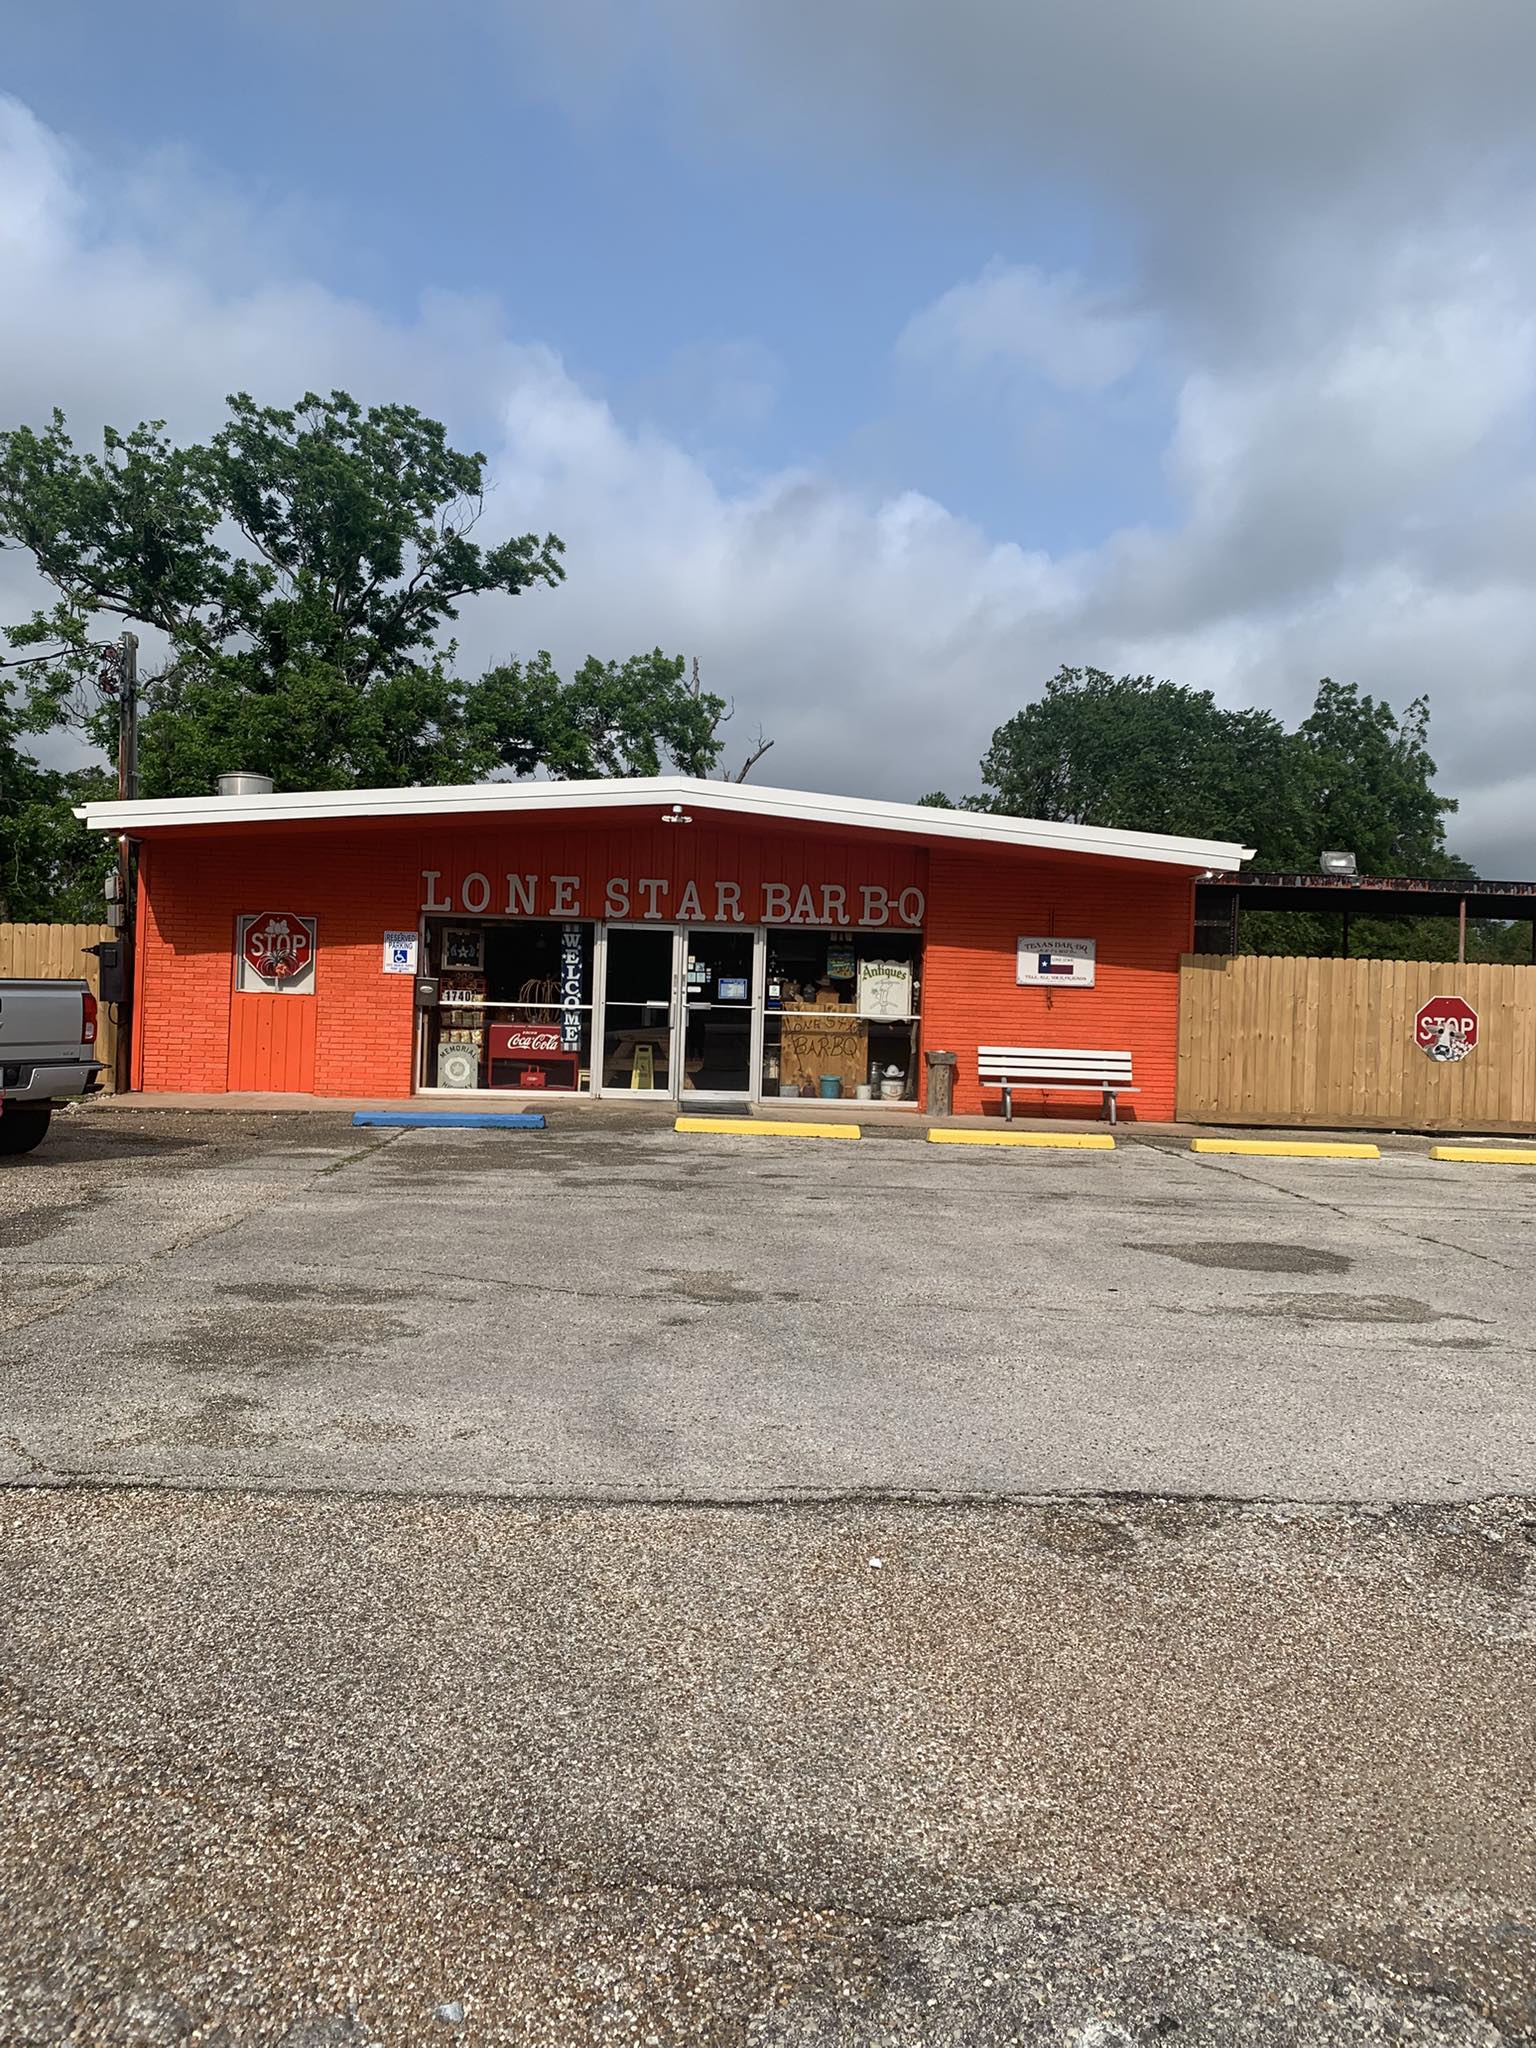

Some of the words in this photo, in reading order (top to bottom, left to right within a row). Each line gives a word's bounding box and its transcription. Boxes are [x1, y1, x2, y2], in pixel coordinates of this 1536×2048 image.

[421, 870, 580, 916] LONE
[605, 877, 745, 922] STAR
[761, 882, 850, 925] BAR
[858, 886, 925, 927] B-Q
[251, 932, 307, 957] STOP
[386, 933, 416, 942] RESERVED
[388, 942, 413, 950] PARKING
[862, 964, 907, 981] Antiques
[563, 933, 581, 1042] WELCOME
[1420, 1016, 1475, 1040] STOP
[440, 1045, 477, 1059] MEMORIAL
